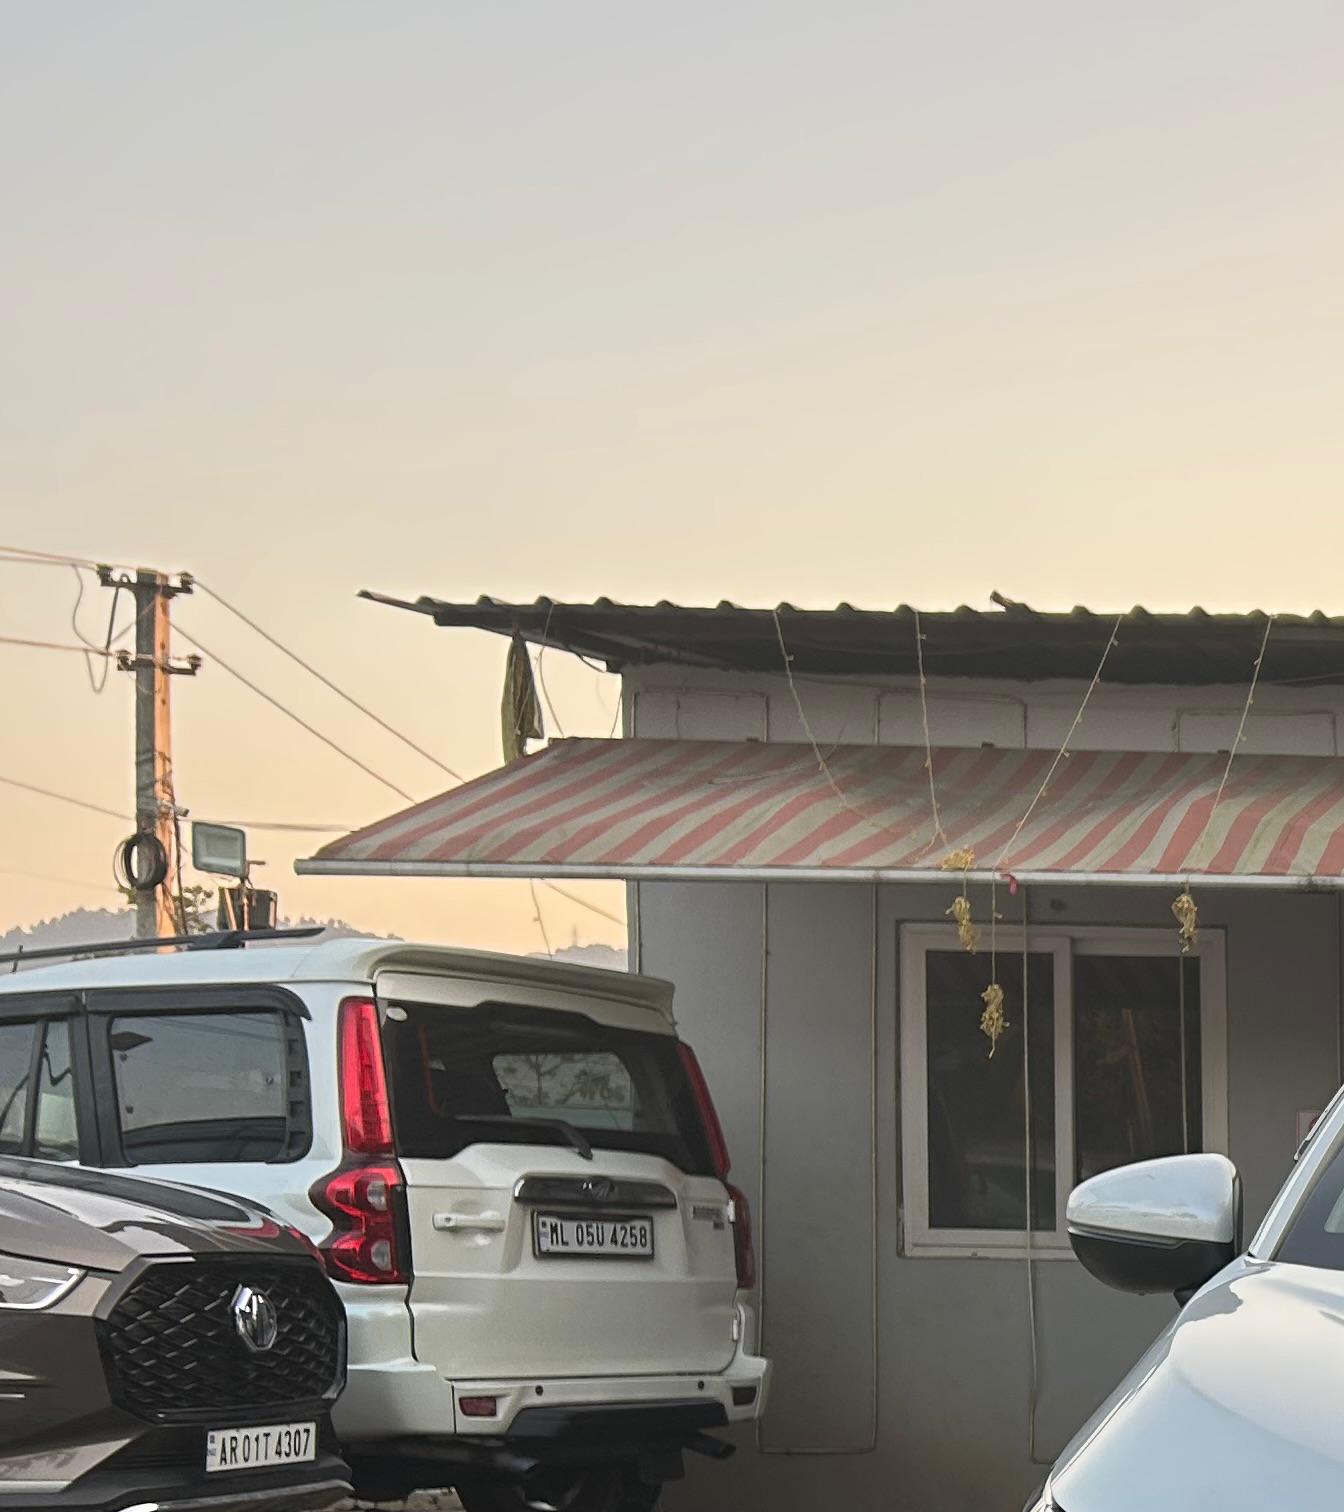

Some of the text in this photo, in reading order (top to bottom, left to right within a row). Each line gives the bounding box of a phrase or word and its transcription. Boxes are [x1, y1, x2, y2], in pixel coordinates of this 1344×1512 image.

[550, 1221, 647, 1248] ML 05U 4258
[275, 1428, 311, 1458] 4307
